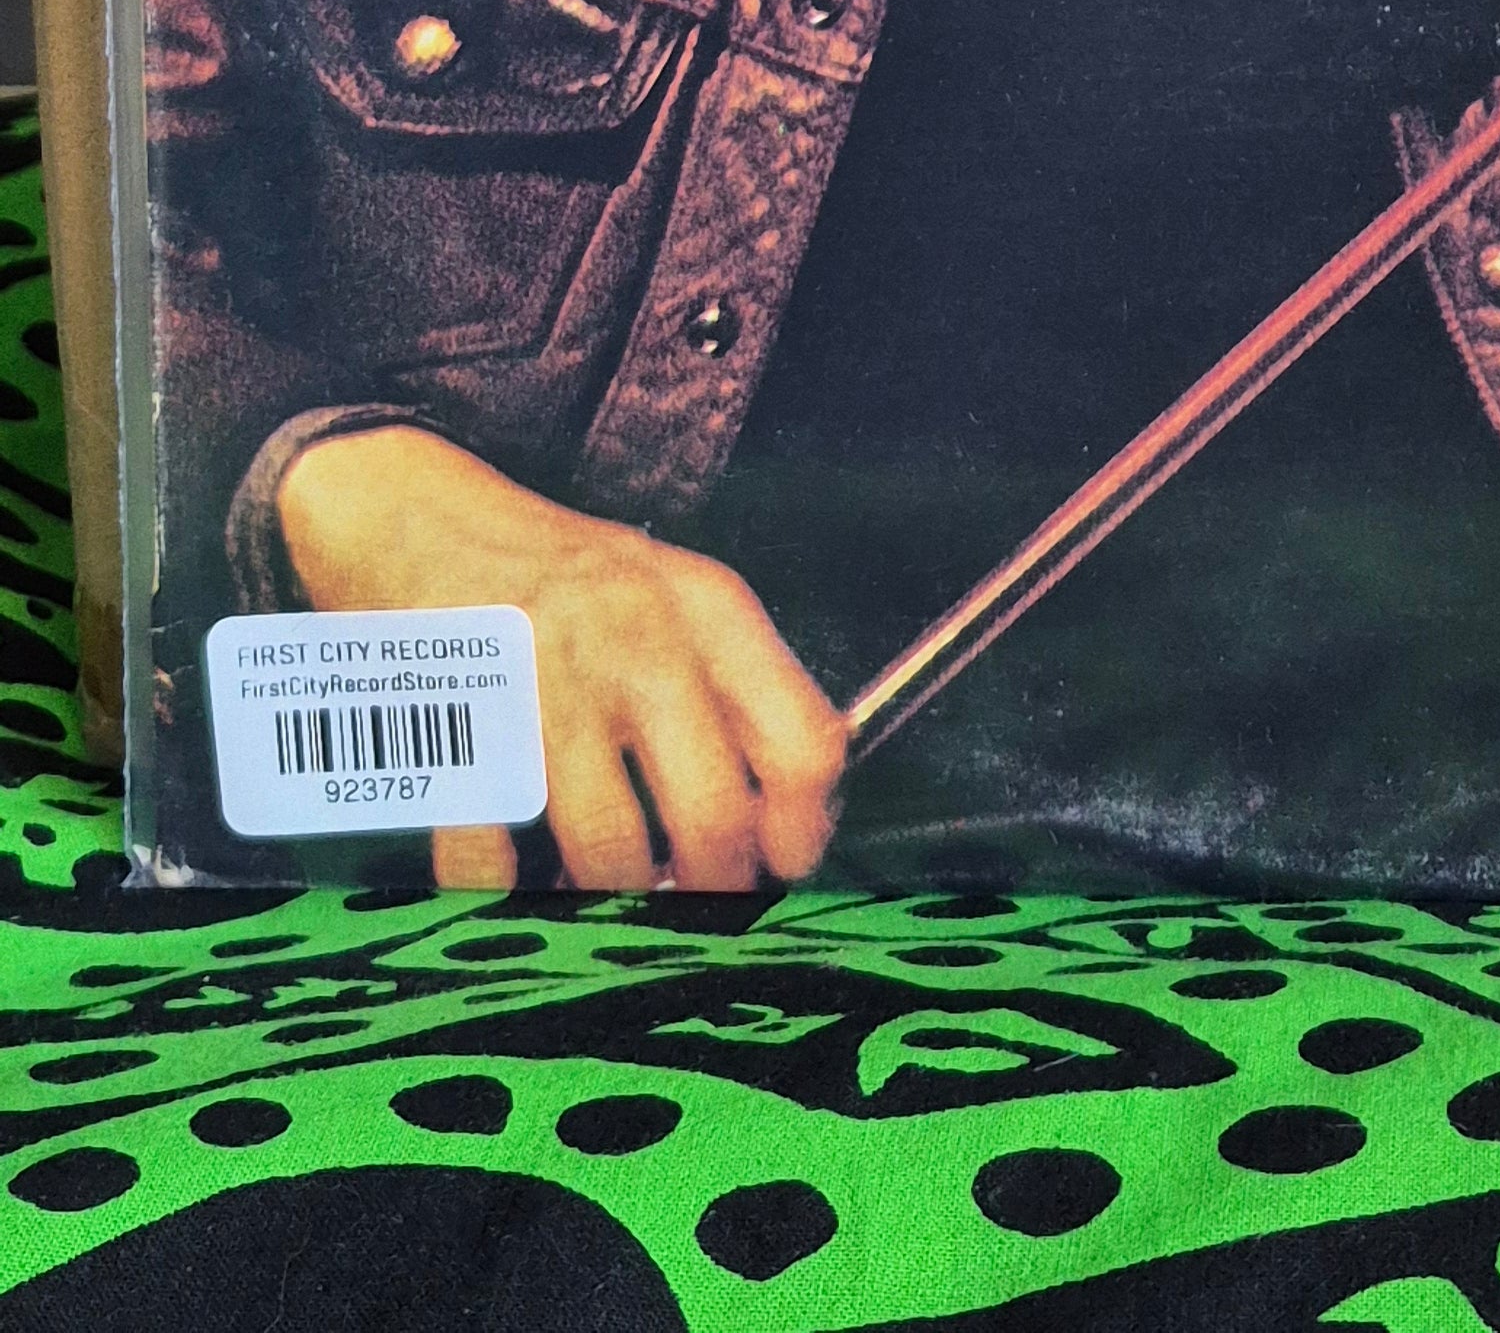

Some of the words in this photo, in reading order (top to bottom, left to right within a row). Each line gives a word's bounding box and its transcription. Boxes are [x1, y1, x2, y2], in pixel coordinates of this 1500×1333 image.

[238, 642, 310, 668] FIRST
[320, 641, 371, 663] CITY
[381, 637, 502, 661] RECORDS
[241, 671, 508, 700] FirstCityRecordStore.com
[324, 775, 433, 804] 923787
